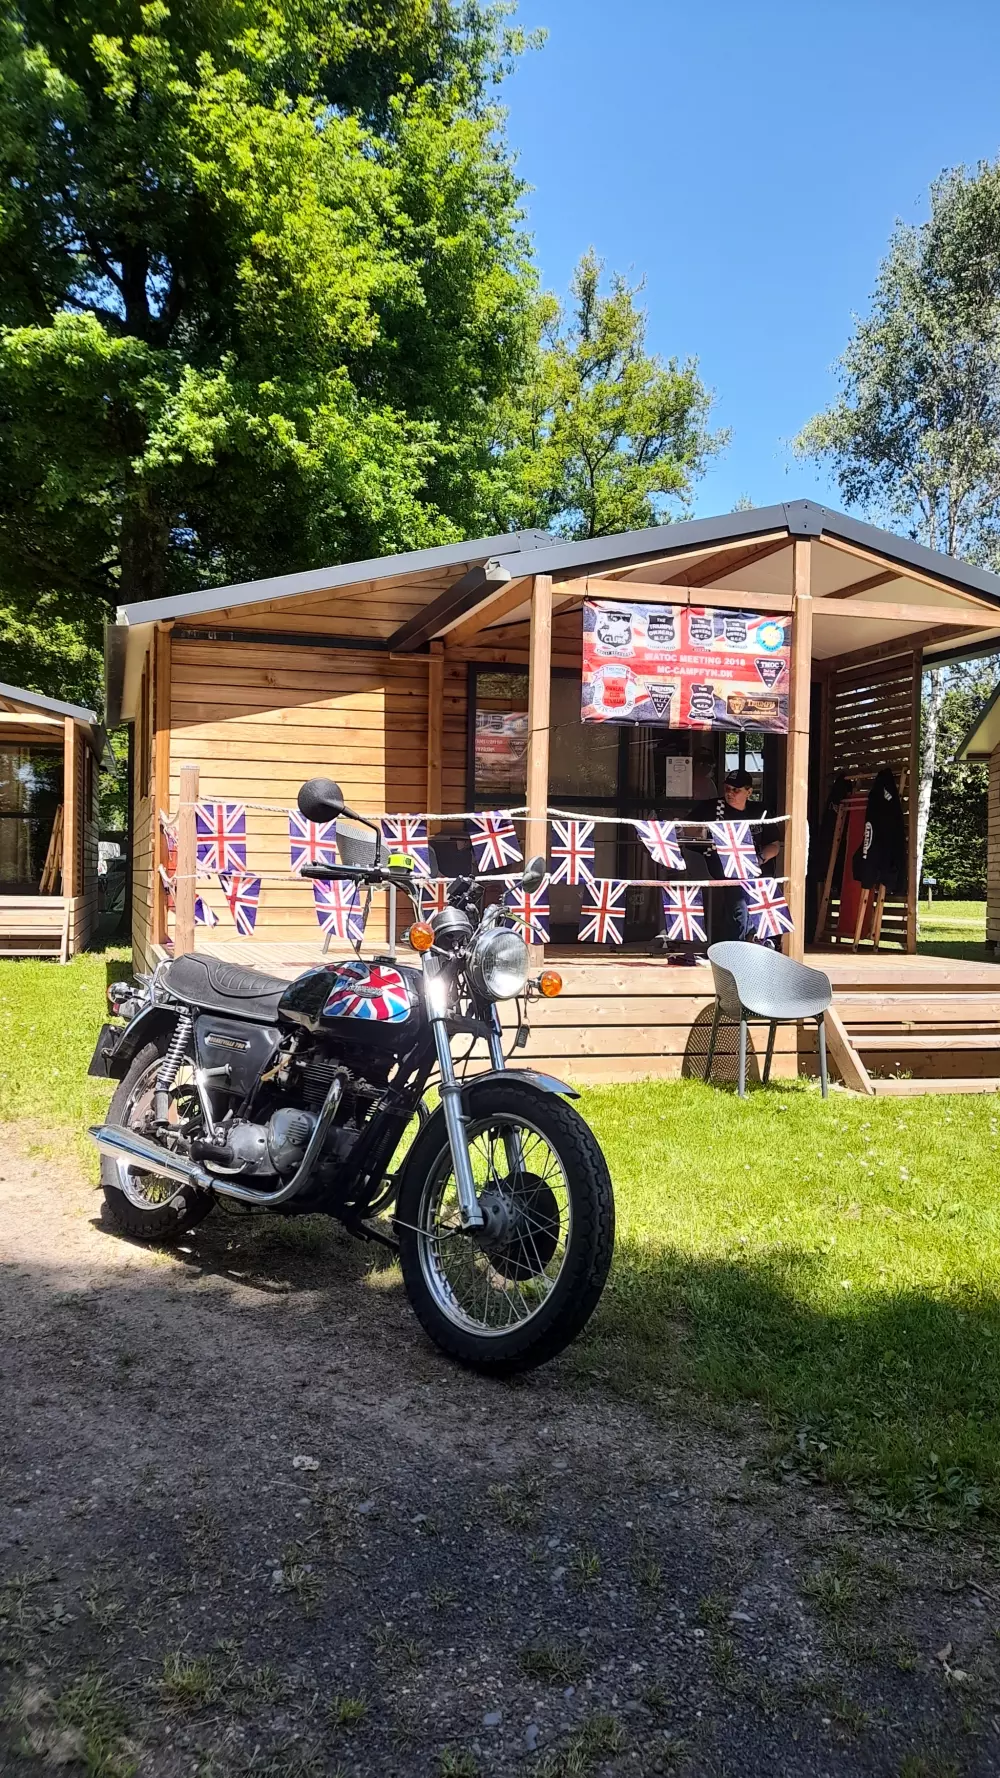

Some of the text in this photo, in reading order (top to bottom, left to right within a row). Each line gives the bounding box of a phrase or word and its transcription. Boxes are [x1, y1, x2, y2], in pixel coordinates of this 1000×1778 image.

[644, 653, 746, 666] WATOC MEETING 2018
